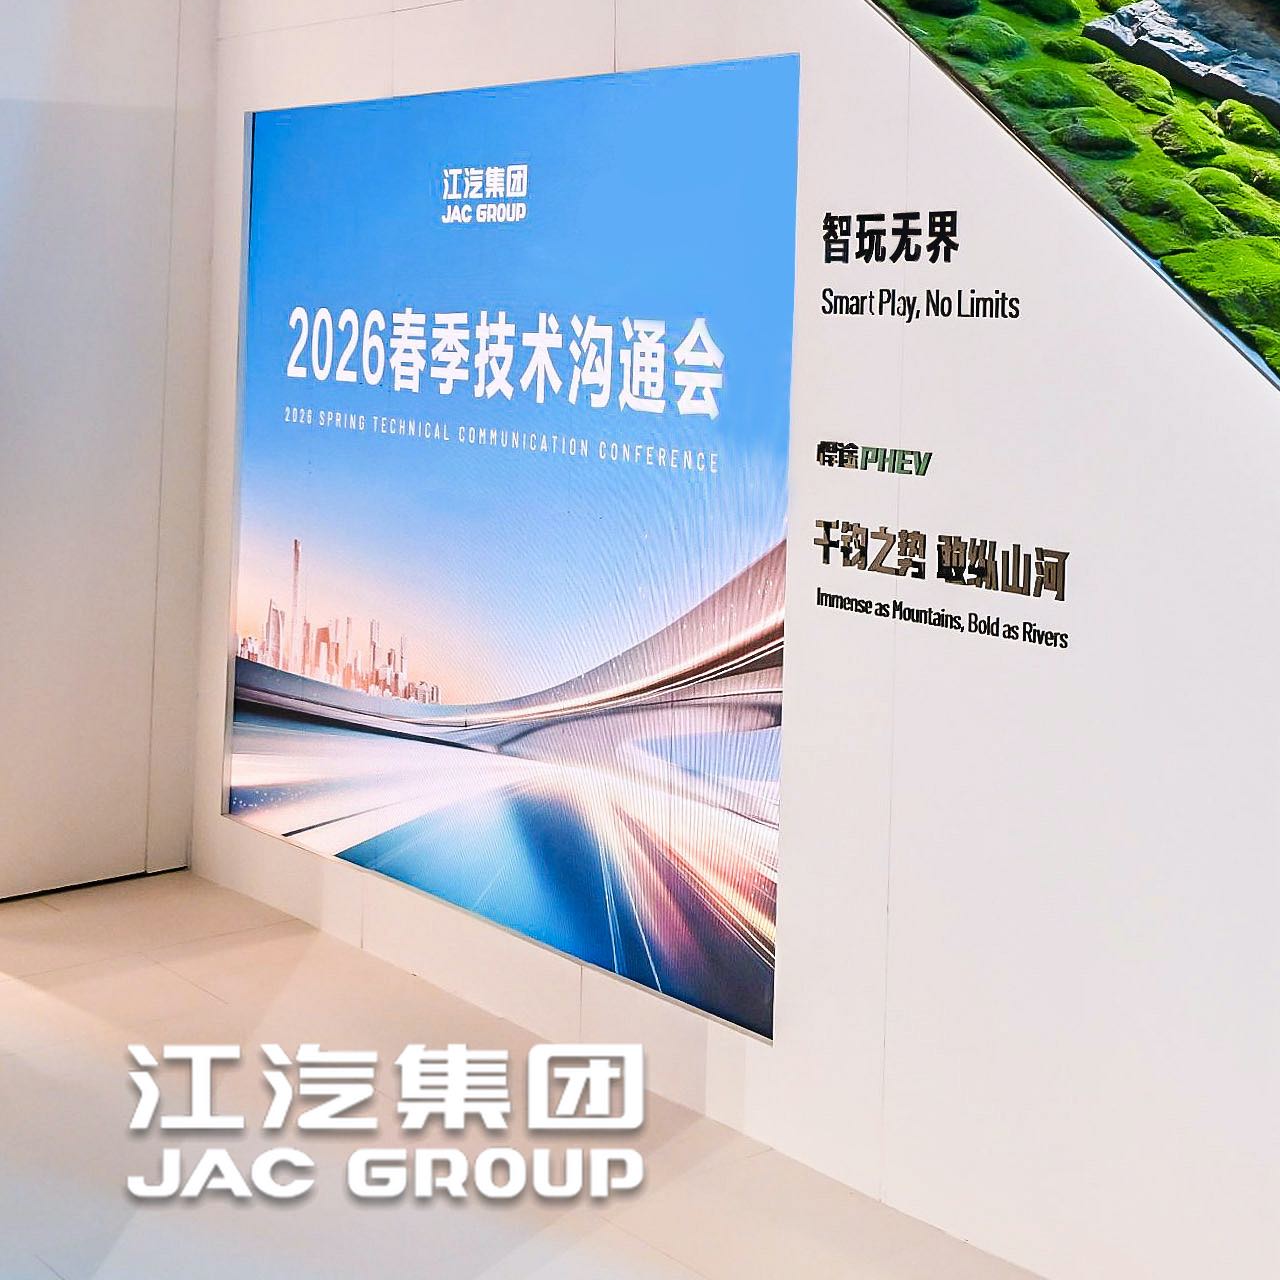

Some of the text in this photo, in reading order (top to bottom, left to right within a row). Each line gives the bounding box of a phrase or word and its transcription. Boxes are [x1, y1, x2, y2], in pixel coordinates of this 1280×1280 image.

[442, 164, 528, 200] 江汽集团
[441, 202, 527, 224] JAC GROUP
[822, 210, 960, 264] 智玩无界
[821, 287, 1021, 324] Smart Play, No Limits
[286, 306, 726, 421] 2026春季技术沟通会
[284, 406, 719, 474] 2026 SPRING TECHNICAL COMMUNICATION CONFERENCE
[817, 587, 1069, 649] Immense as Mountains, Bold as Rivers
